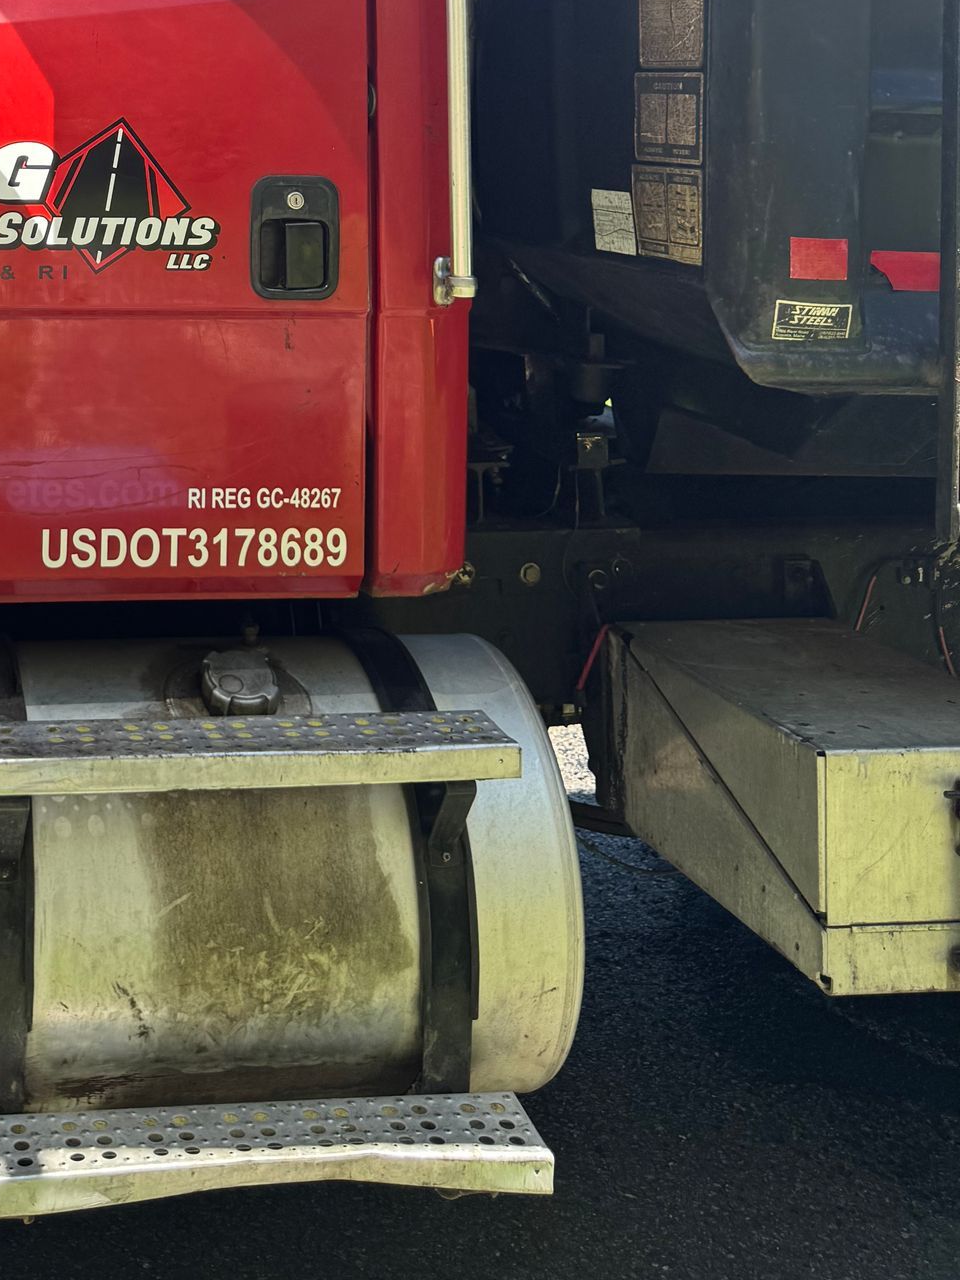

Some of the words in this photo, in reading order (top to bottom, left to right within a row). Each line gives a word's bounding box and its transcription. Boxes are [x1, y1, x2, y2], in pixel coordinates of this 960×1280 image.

[166, 253, 213, 271] LLC
[0, 264, 16, 280] &
[38, 264, 69, 280] RI
[789, 315, 834, 326] STEEL
[187, 488, 206, 508] RI
[211, 488, 251, 508] REG
[256, 487, 341, 508] GC-48267
[41, 527, 347, 568] USDOT3178689
